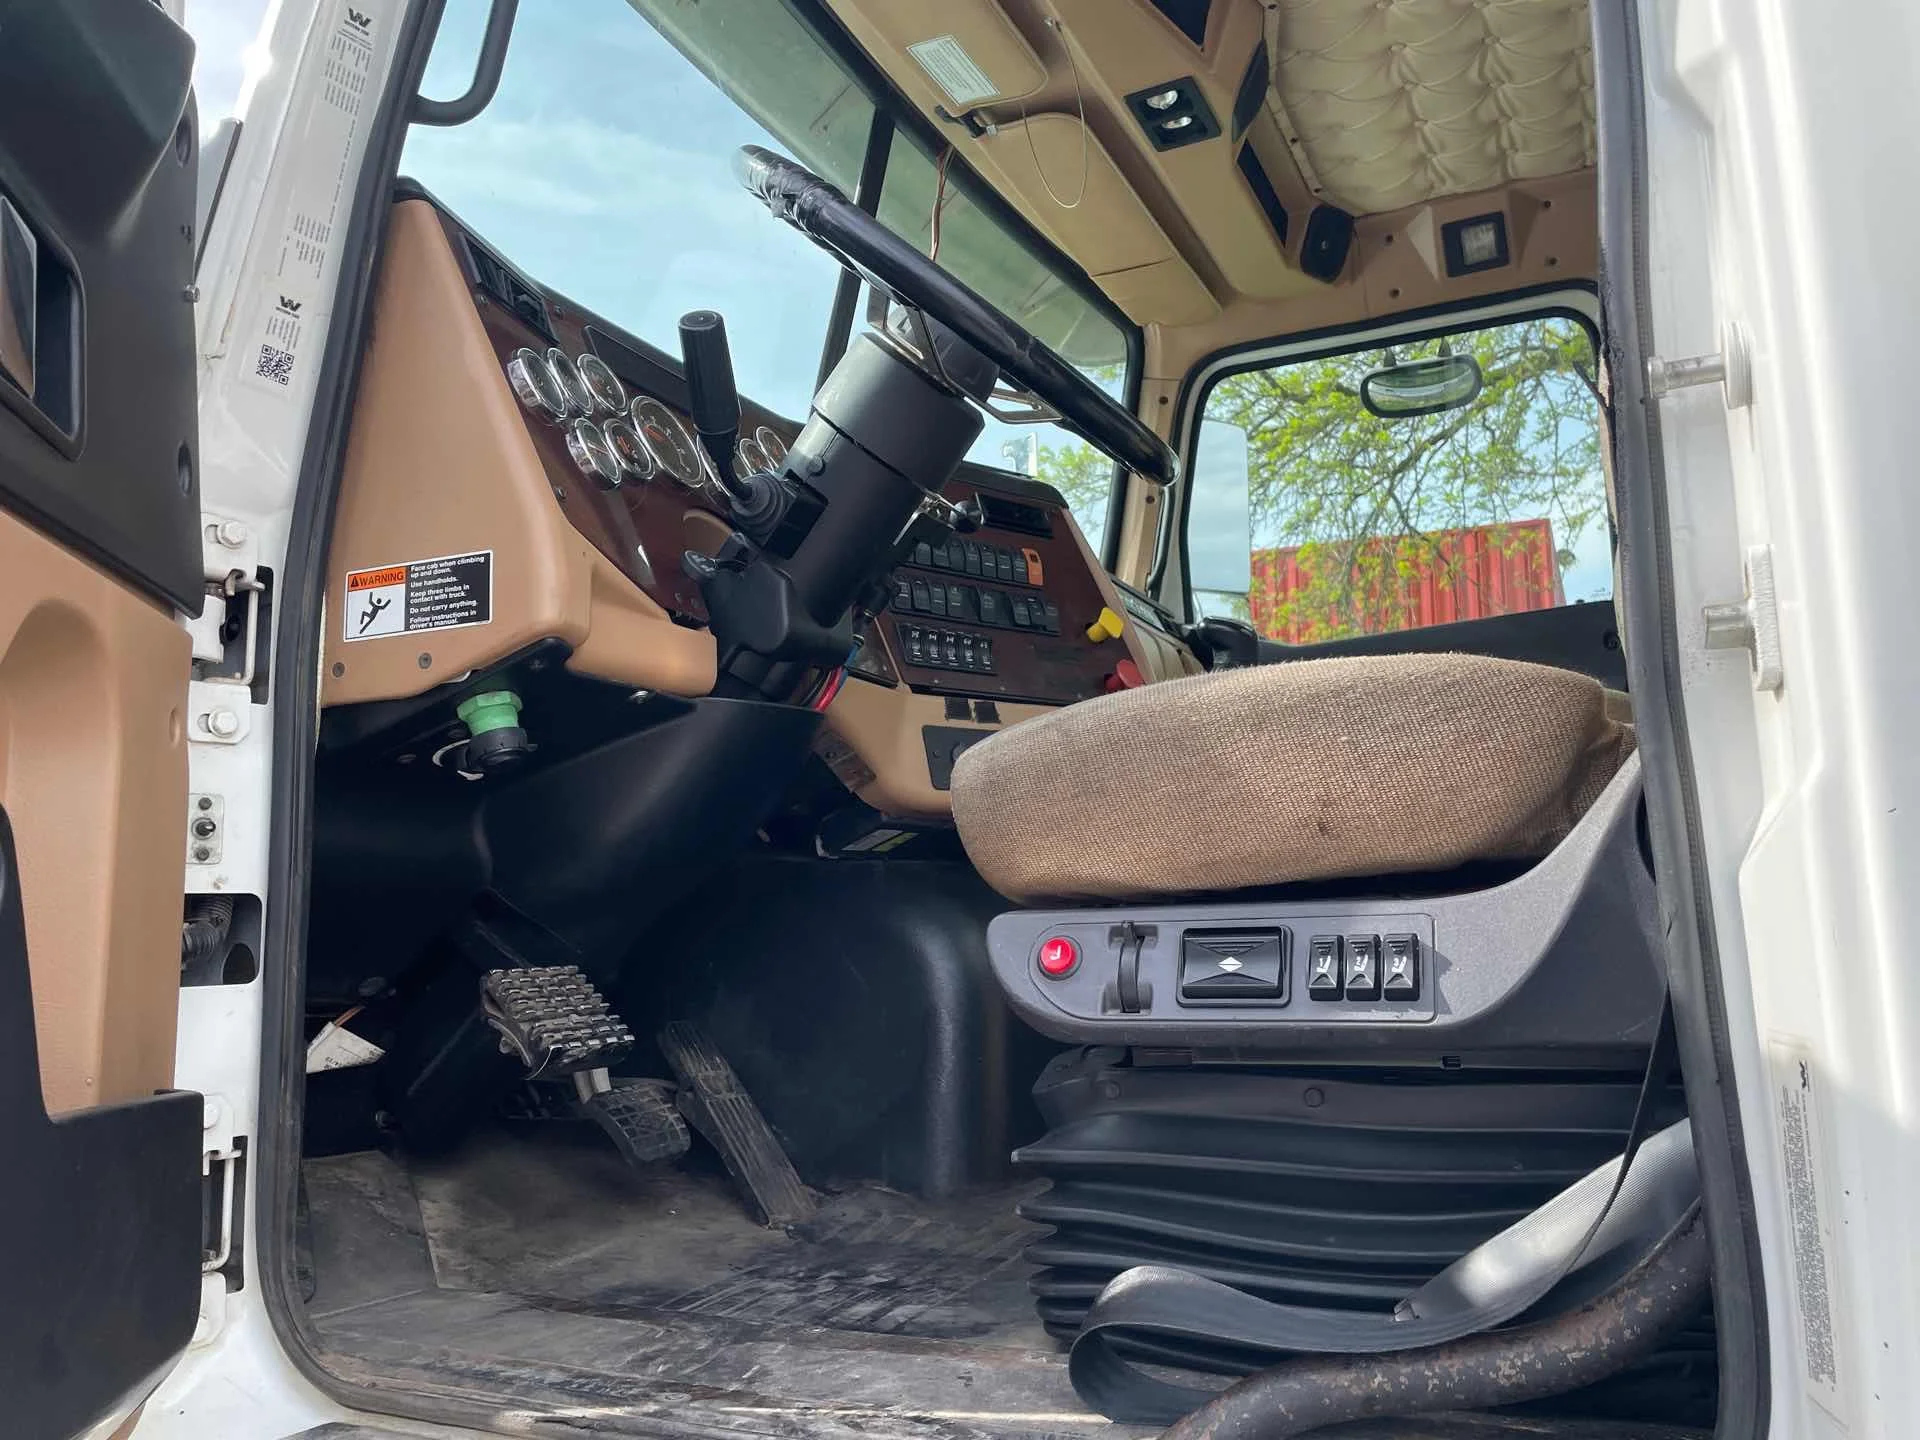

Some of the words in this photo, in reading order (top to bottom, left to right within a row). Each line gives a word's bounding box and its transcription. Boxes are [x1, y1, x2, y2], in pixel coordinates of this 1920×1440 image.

[439, 560, 456, 568] when
[457, 556, 485, 564] climbing
[433, 567, 452, 575] down.
[360, 571, 404, 587] WARNING
[424, 576, 459, 586] handholds.
[410, 595, 433, 604] contact
[449, 591, 466, 599] truck.
[449, 600, 478, 609] anything.
[410, 616, 431, 624] Follow
[432, 611, 468, 620] instructions
[410, 621, 433, 630] driver's
[434, 618, 459, 627] manual.
